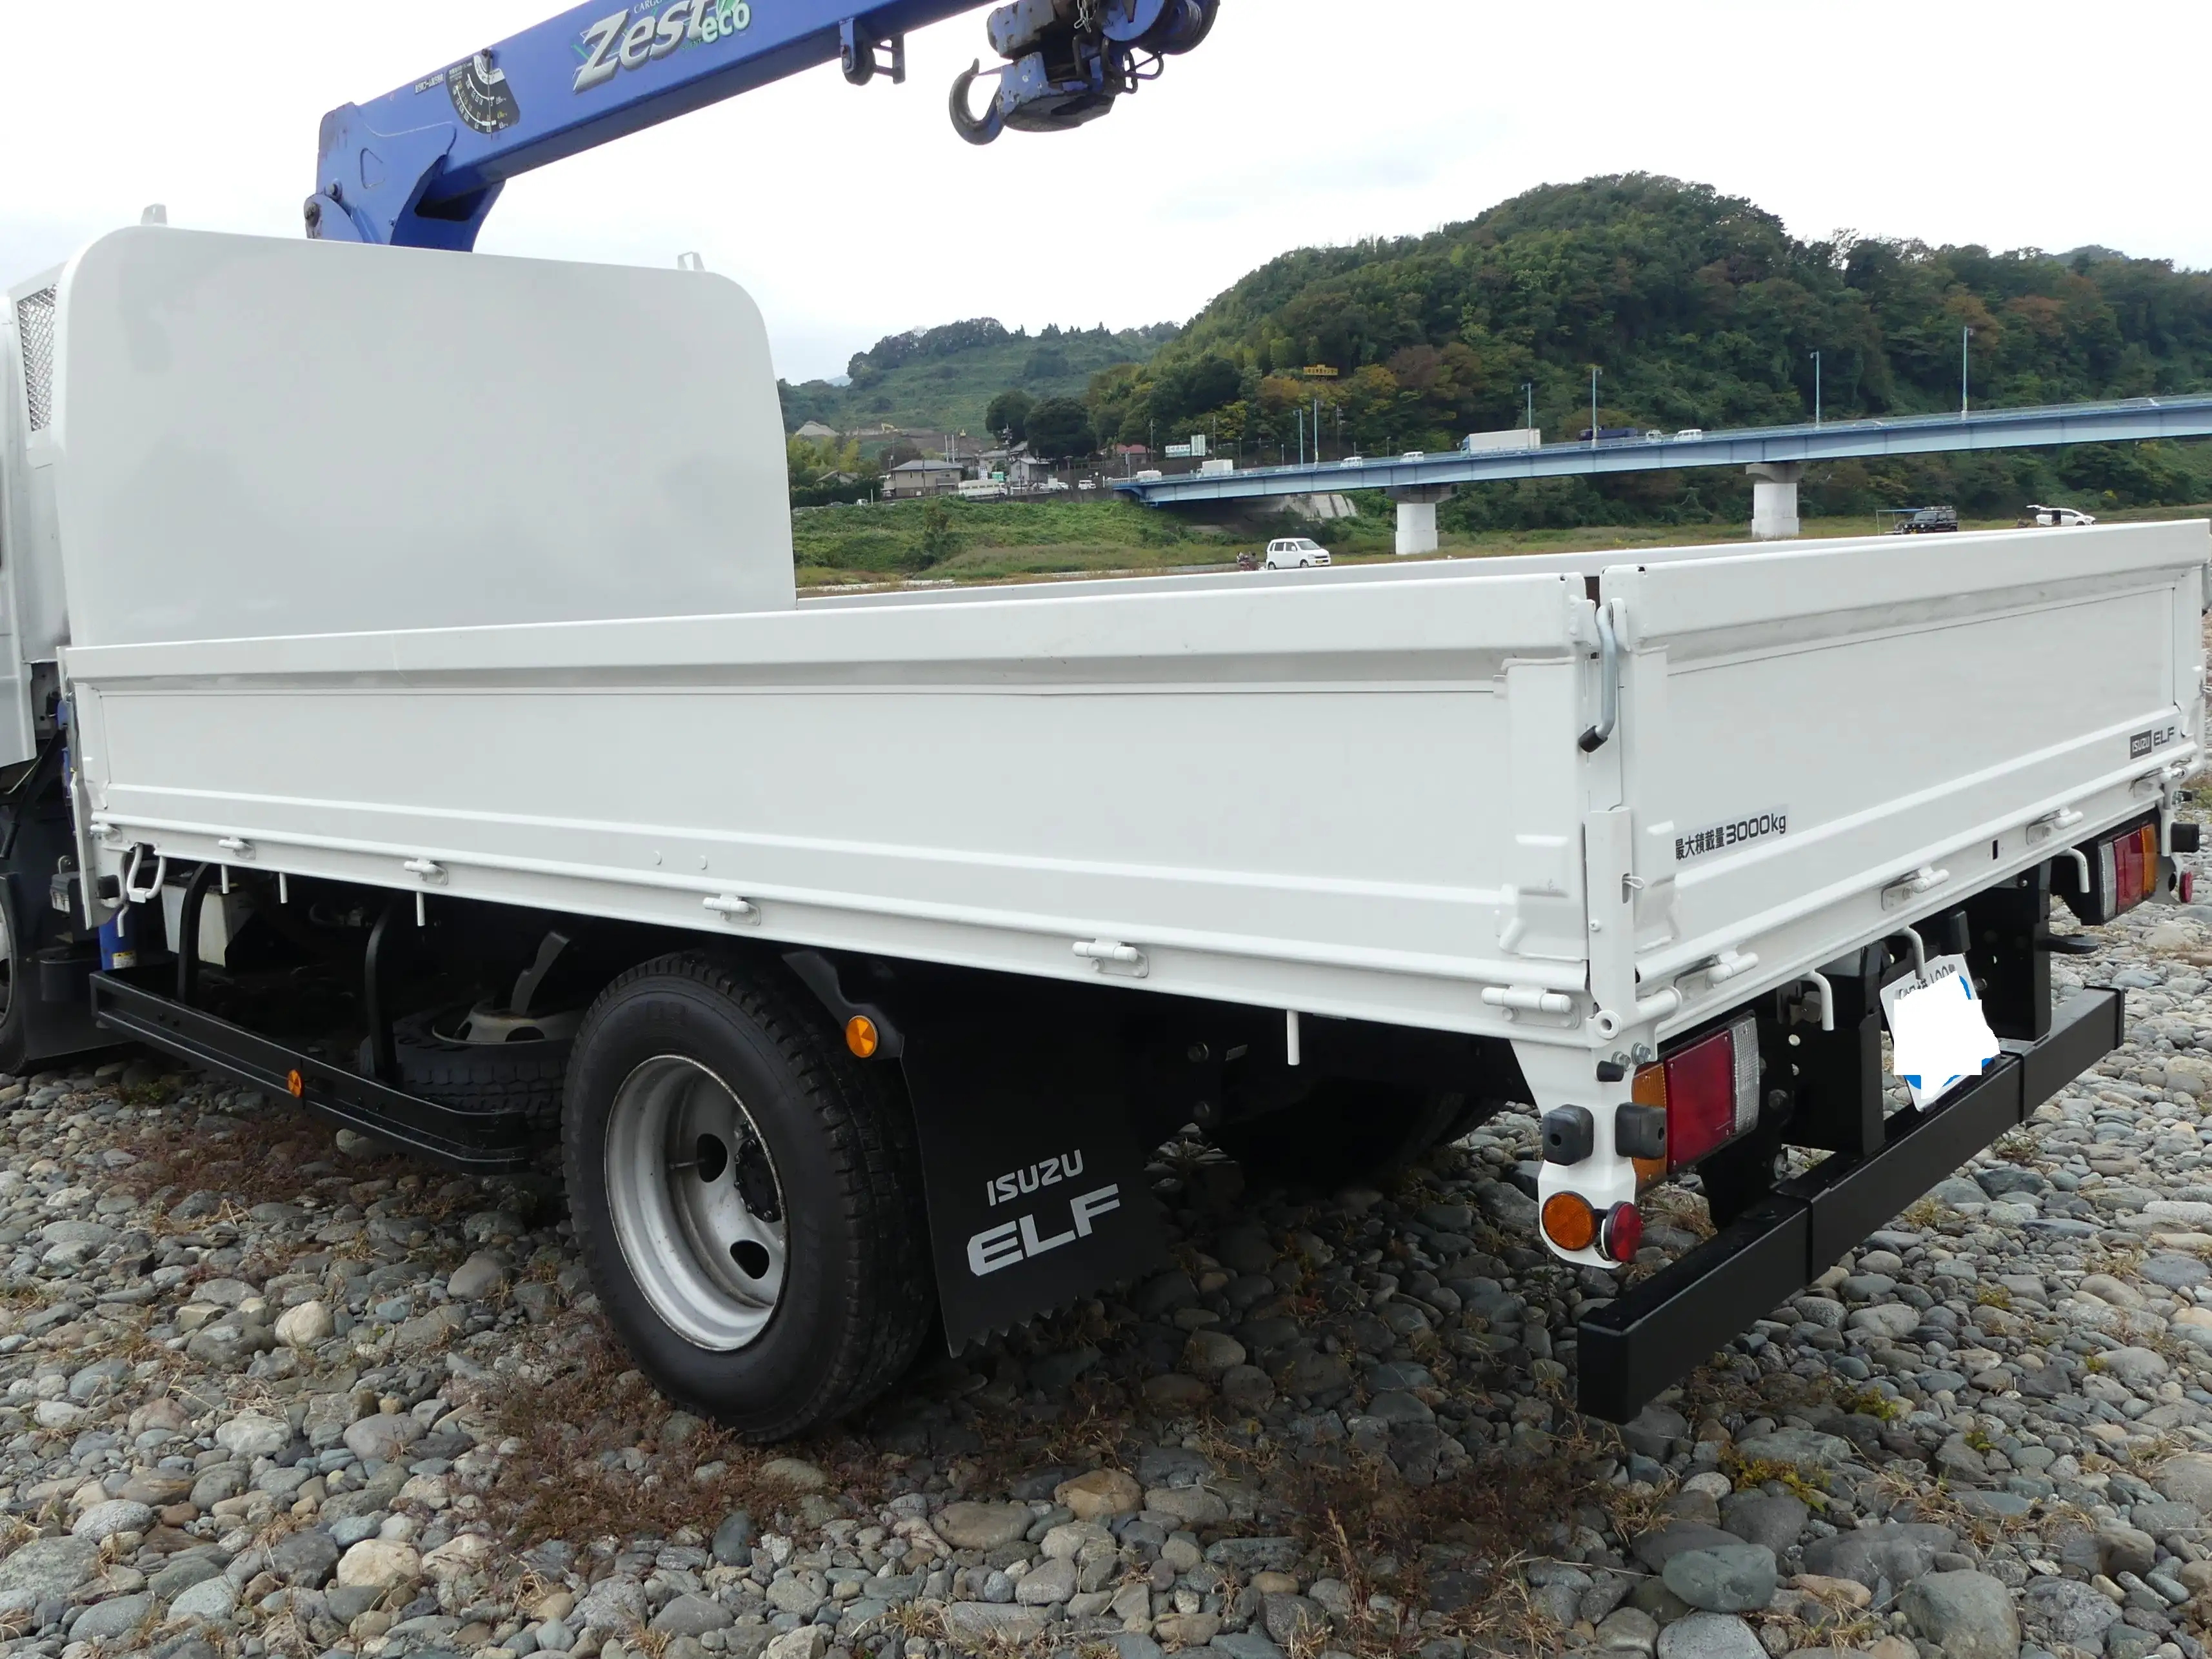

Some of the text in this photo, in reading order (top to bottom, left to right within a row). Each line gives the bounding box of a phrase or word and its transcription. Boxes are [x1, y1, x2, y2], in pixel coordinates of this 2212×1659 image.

[573, 0, 710, 92] Zest
[702, 3, 750, 43] eco
[2131, 726, 2175, 753] ISUZU ELF
[986, 1149, 1084, 1207] ISUZU
[966, 1183, 1121, 1277] ELF
